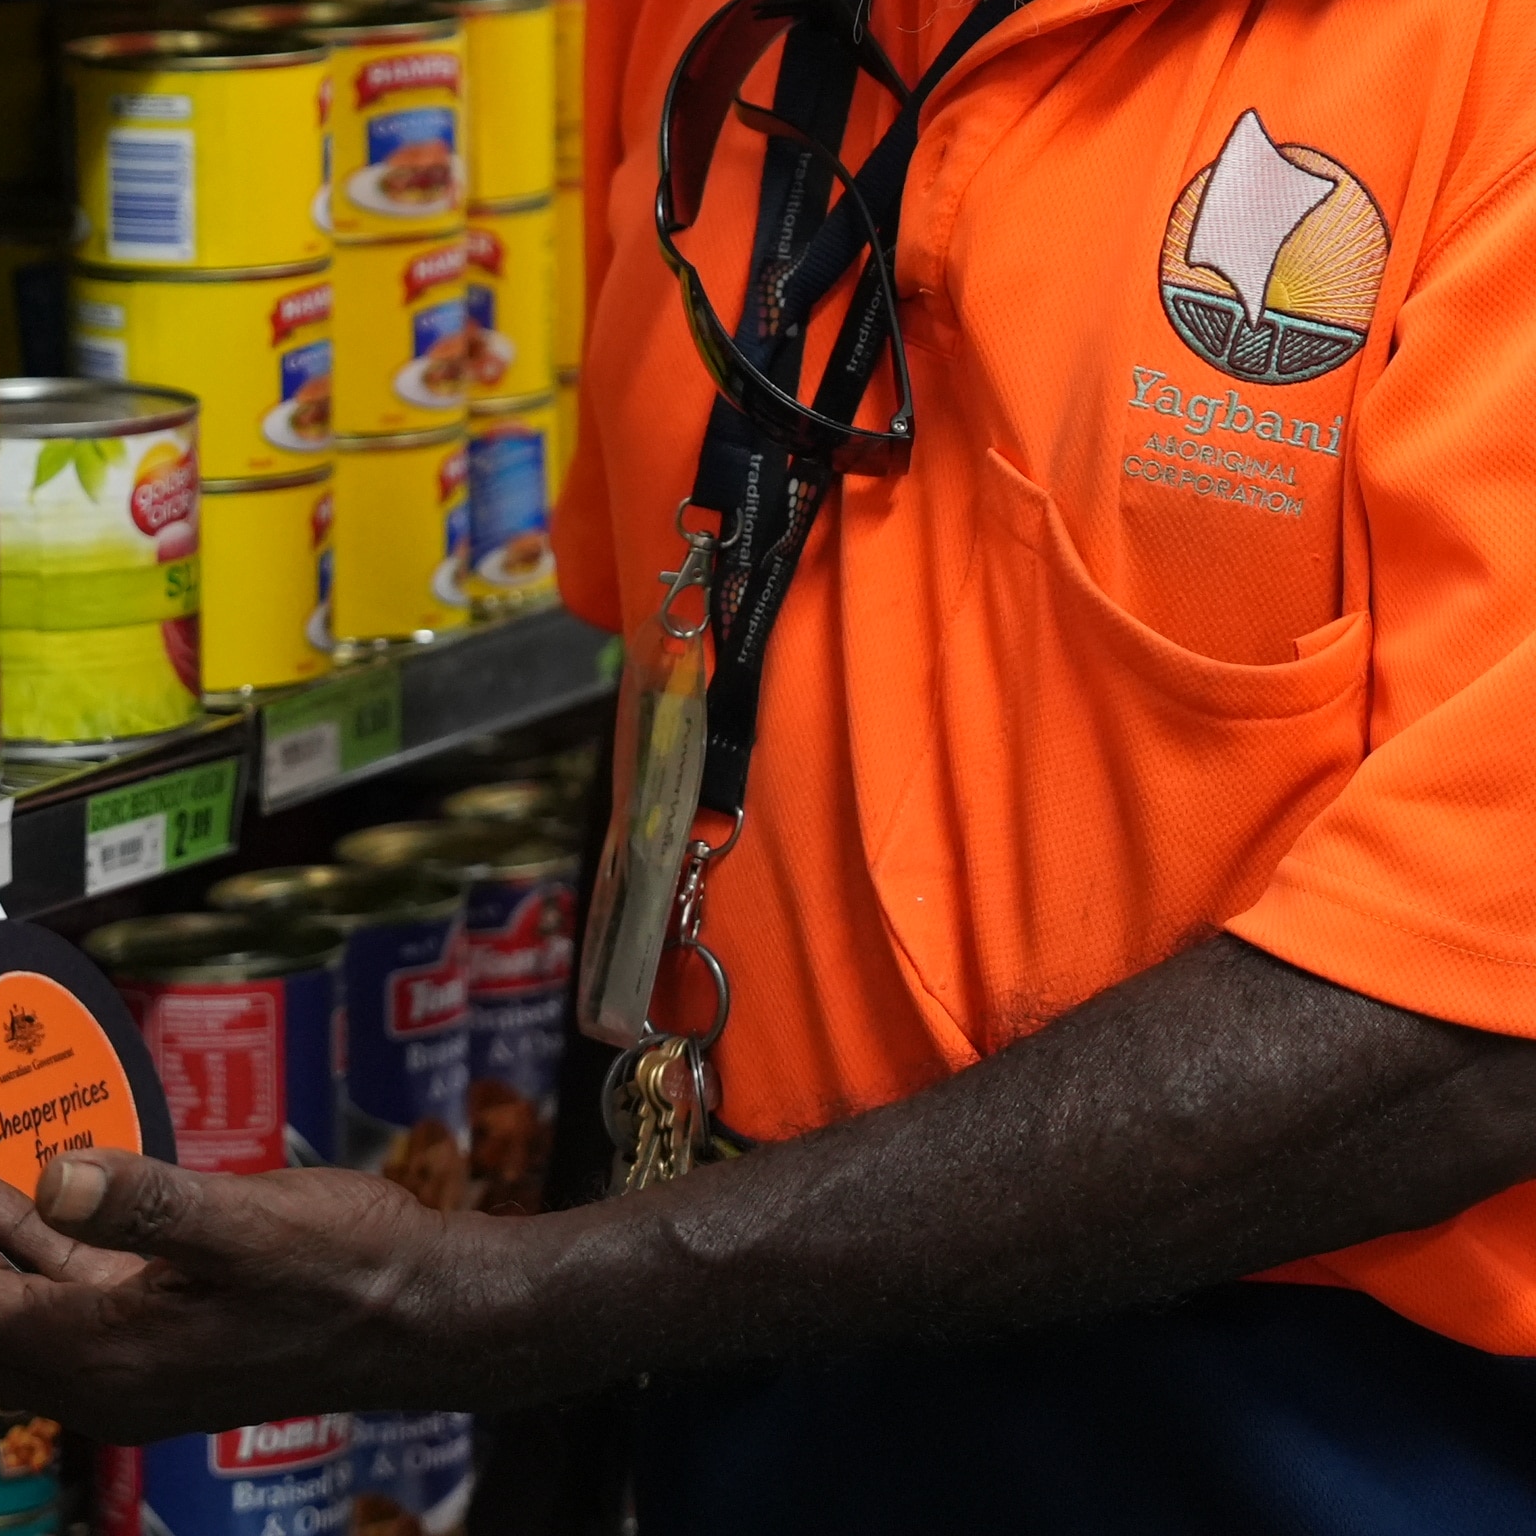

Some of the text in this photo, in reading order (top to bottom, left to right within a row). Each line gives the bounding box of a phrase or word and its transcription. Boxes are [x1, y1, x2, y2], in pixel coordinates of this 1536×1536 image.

[1129, 366, 1344, 457] Yagbani
[1124, 455, 1305, 517] CORPORATION
[1144, 432, 1297, 487] ABORIGINAL
[739, 453, 763, 568] traditional
[737, 554, 784, 664] traditional
[32, 1047, 75, 1071] Government
[60, 1079, 110, 1126] prices
[35, 1138, 59, 1169] for
